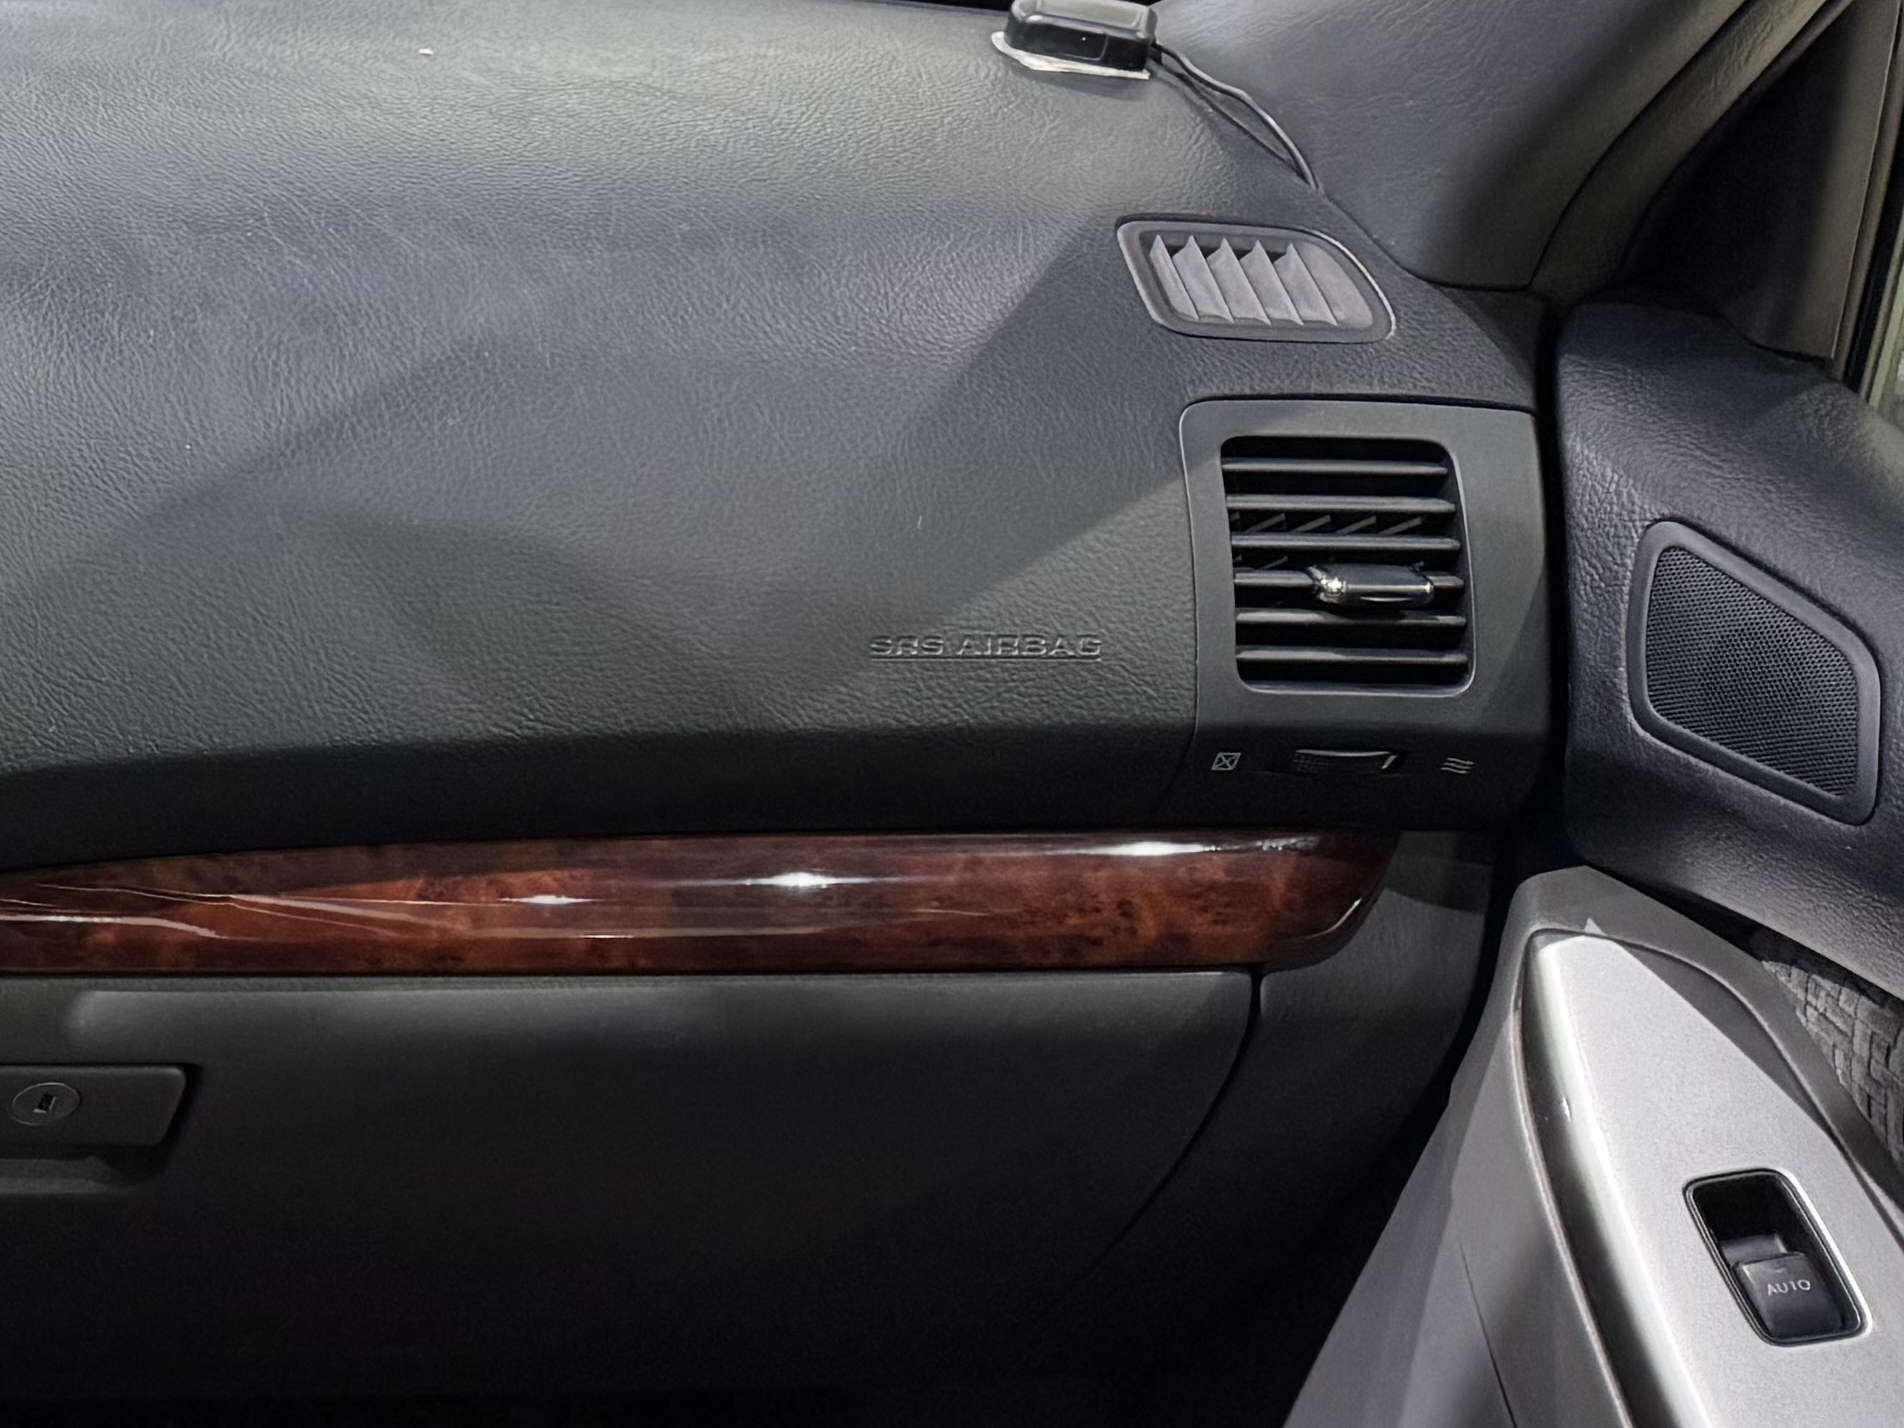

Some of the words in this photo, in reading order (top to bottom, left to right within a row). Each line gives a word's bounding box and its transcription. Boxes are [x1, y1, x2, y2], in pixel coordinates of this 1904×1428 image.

[870, 634, 945, 656] SRS
[956, 633, 1103, 657] AIRBAG
[1767, 1279, 1811, 1297] AUTO
